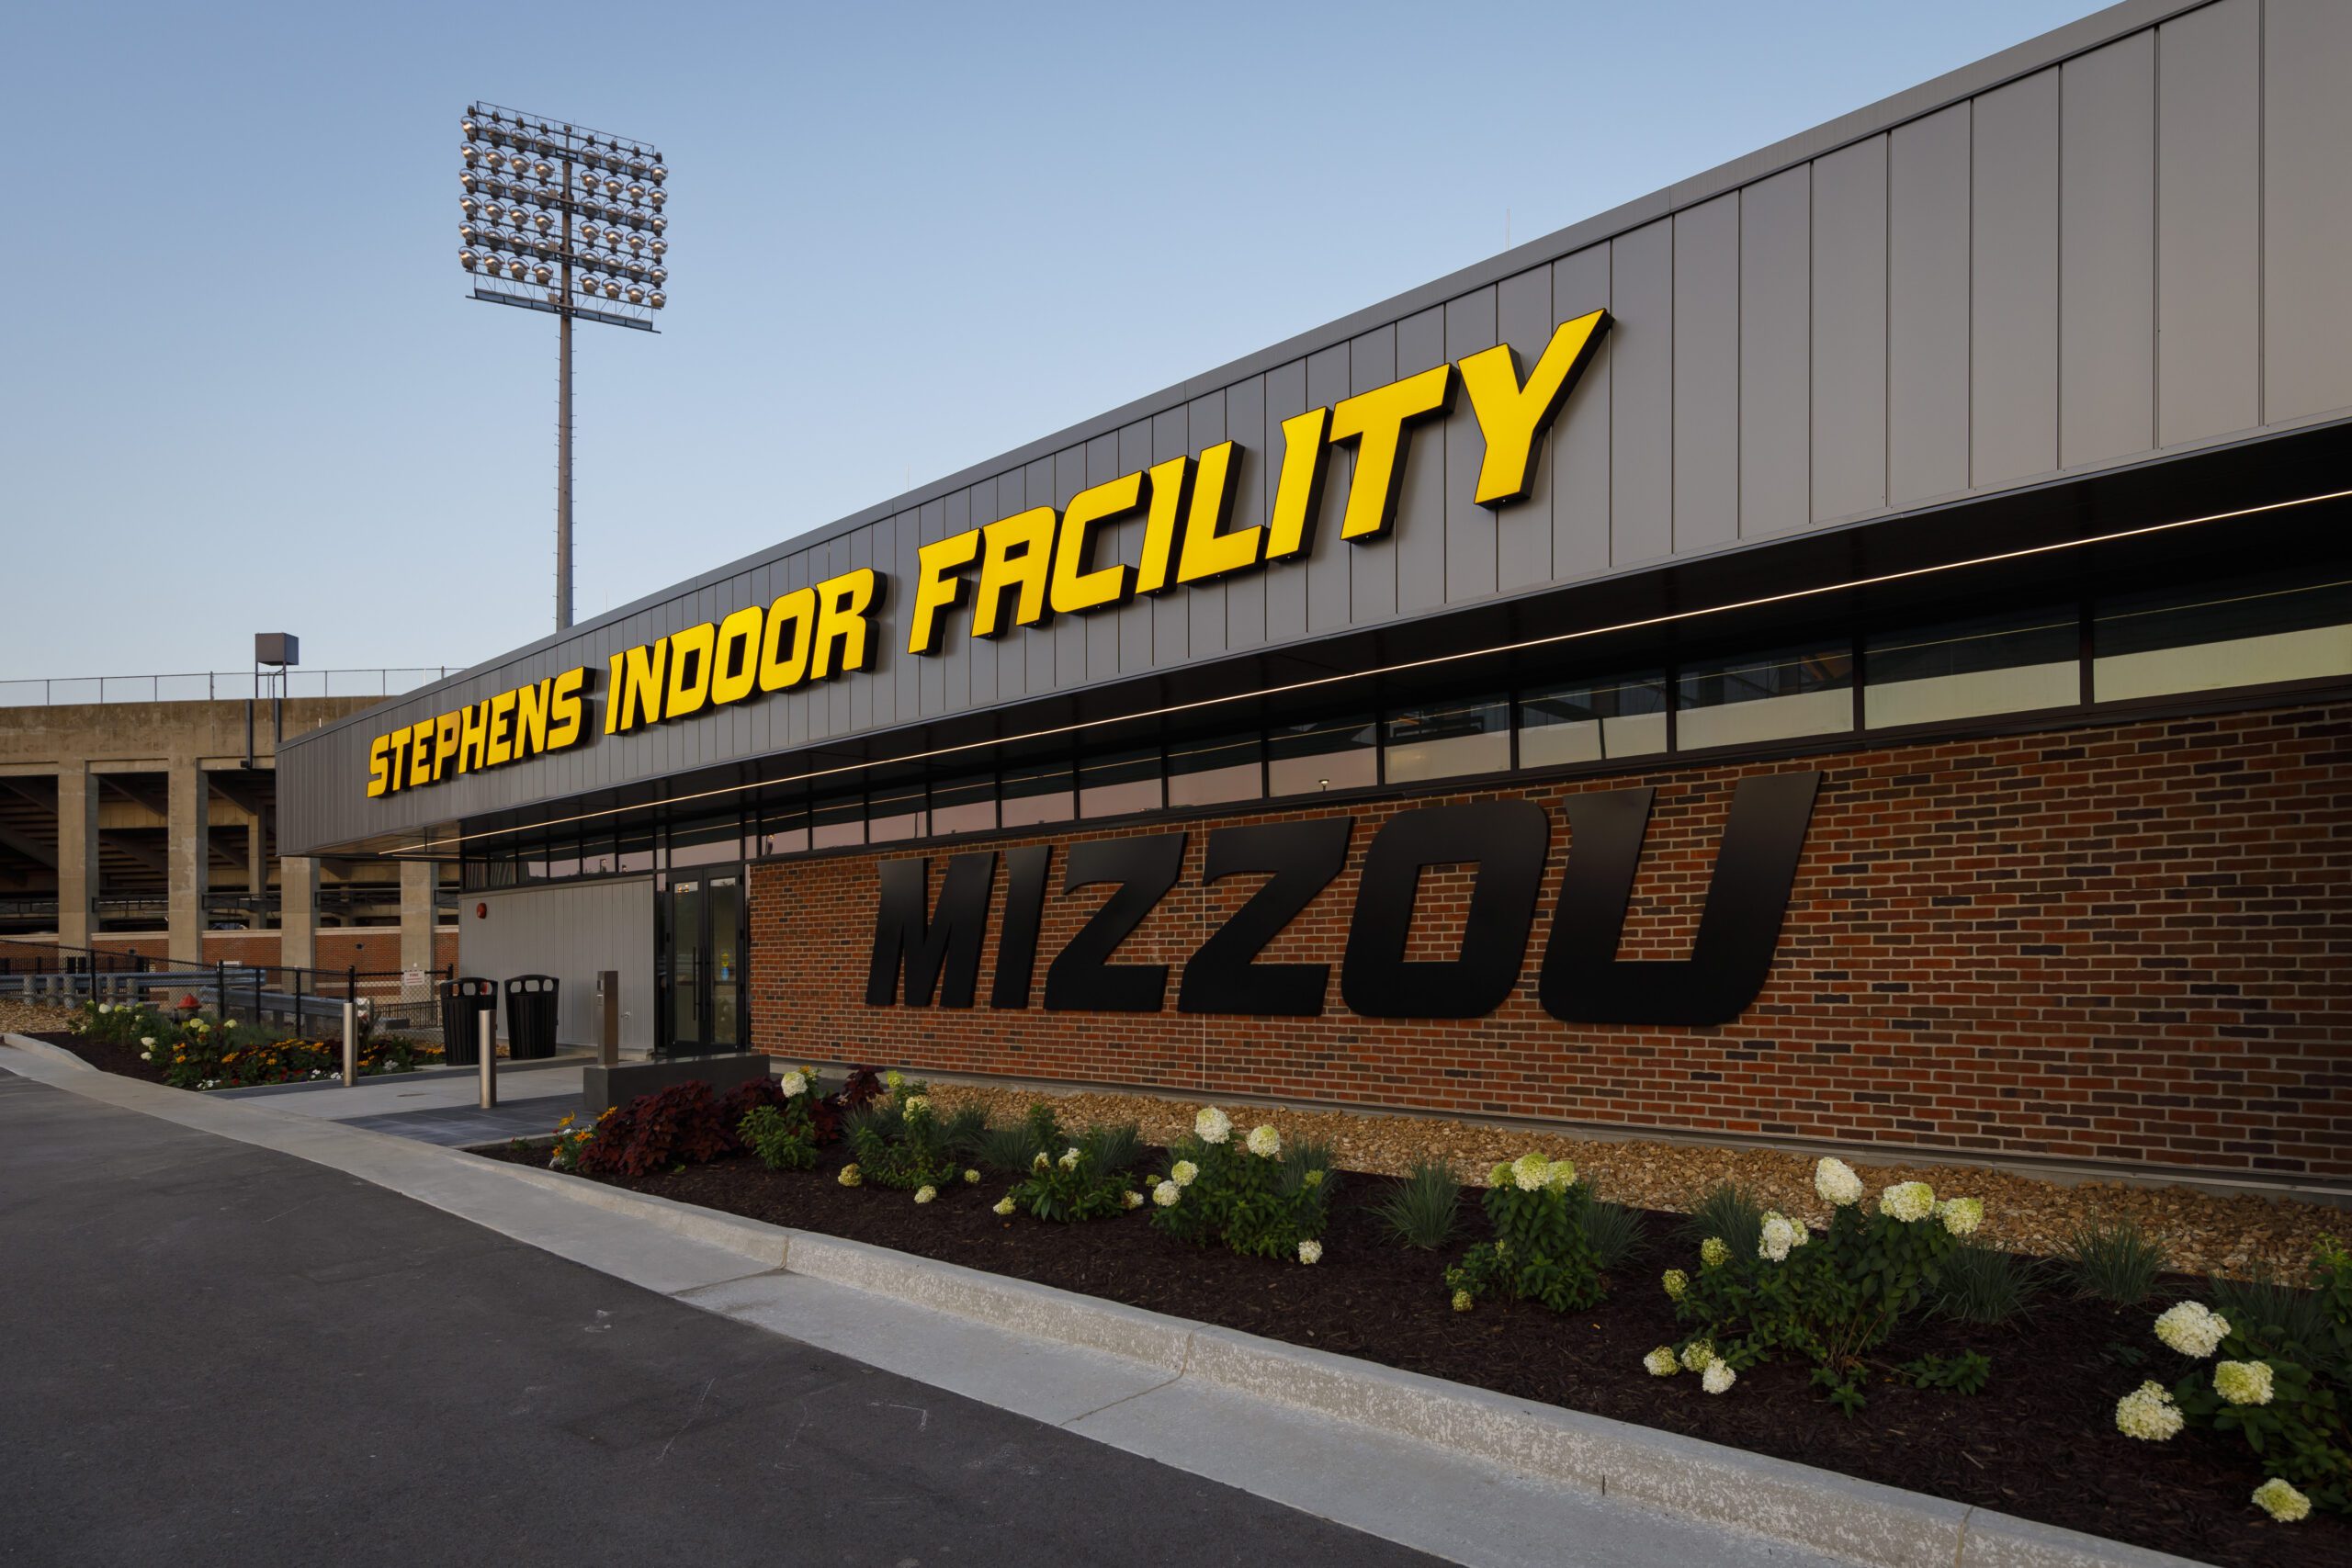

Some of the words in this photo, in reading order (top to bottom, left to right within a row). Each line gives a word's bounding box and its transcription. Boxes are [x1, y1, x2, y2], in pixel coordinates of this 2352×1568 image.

[367, 665, 586, 799] STEPHENS
[604, 567, 877, 736] INDOOR
[907, 309, 1607, 655] FACILITY
[865, 770, 1824, 1028] MIZZOU
